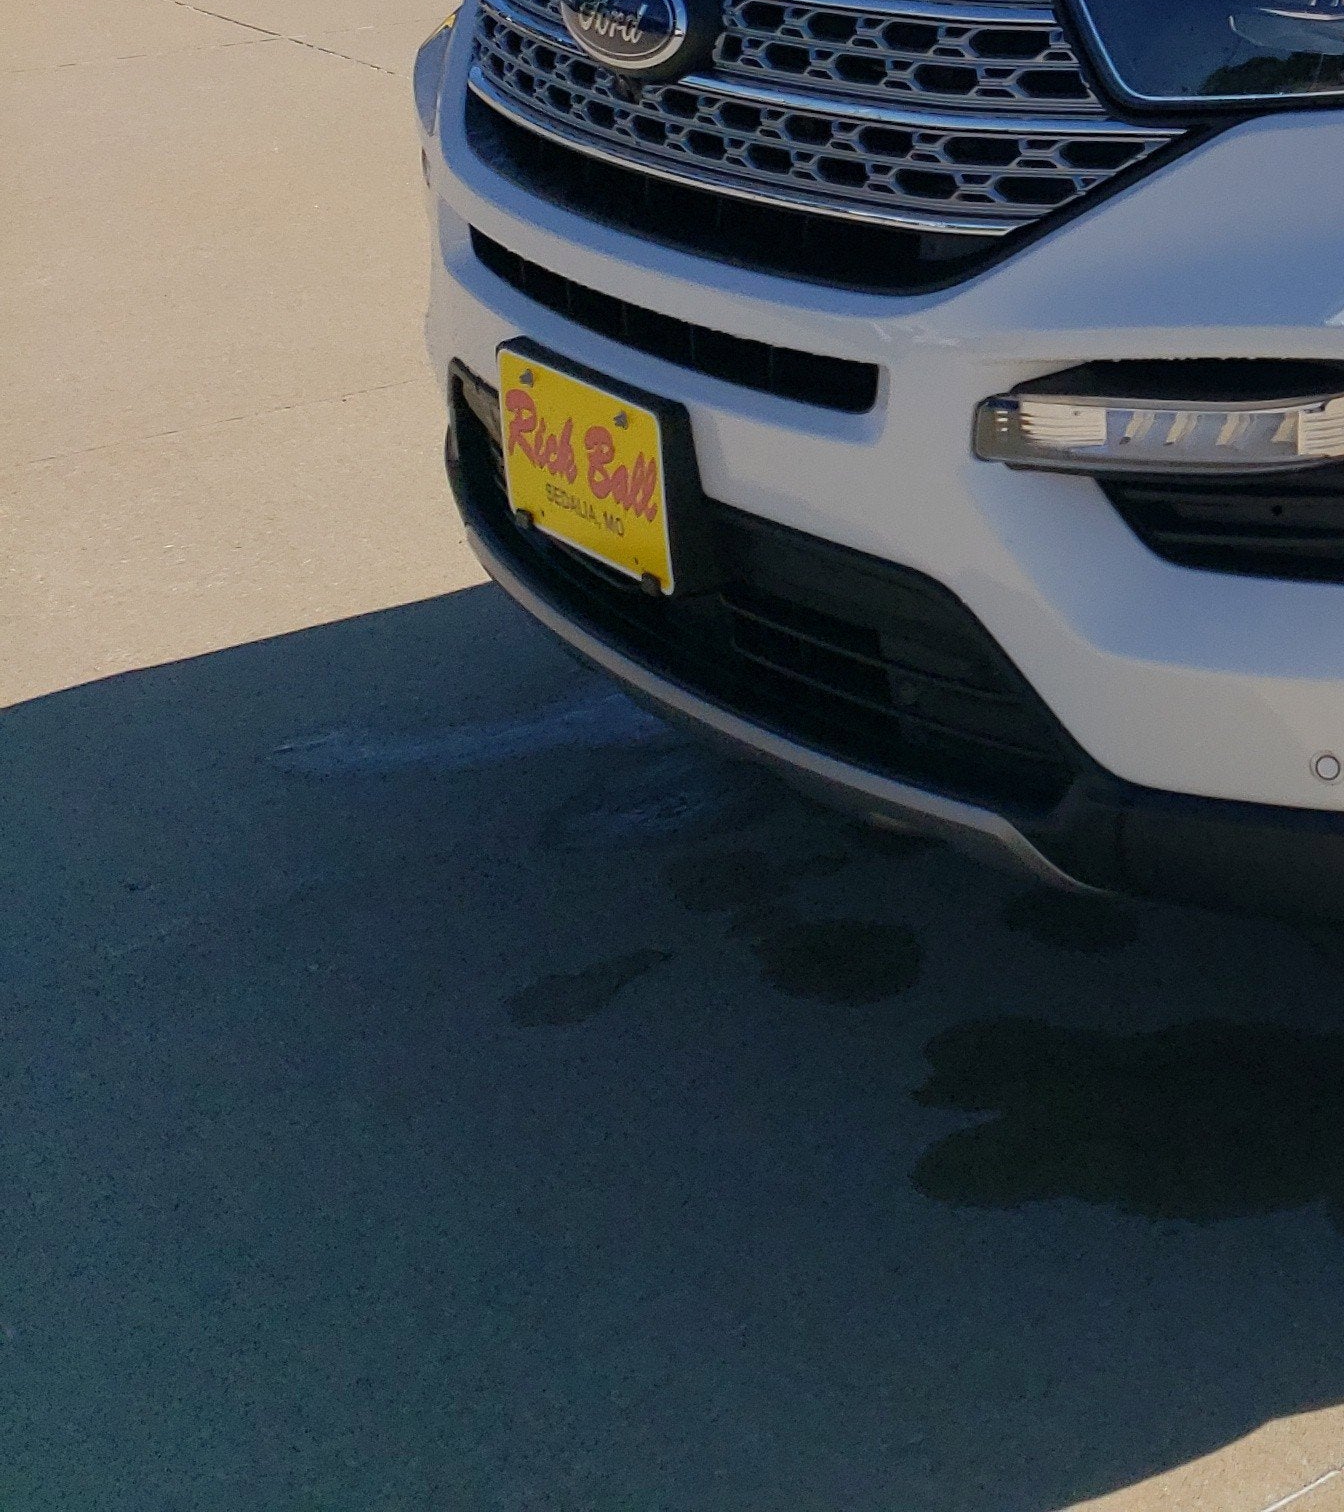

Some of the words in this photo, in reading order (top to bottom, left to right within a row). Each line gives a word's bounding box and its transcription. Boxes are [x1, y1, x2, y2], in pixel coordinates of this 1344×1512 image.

[505, 389, 578, 484] Rich
[584, 426, 658, 523] Ball
[603, 510, 625, 537] MO
